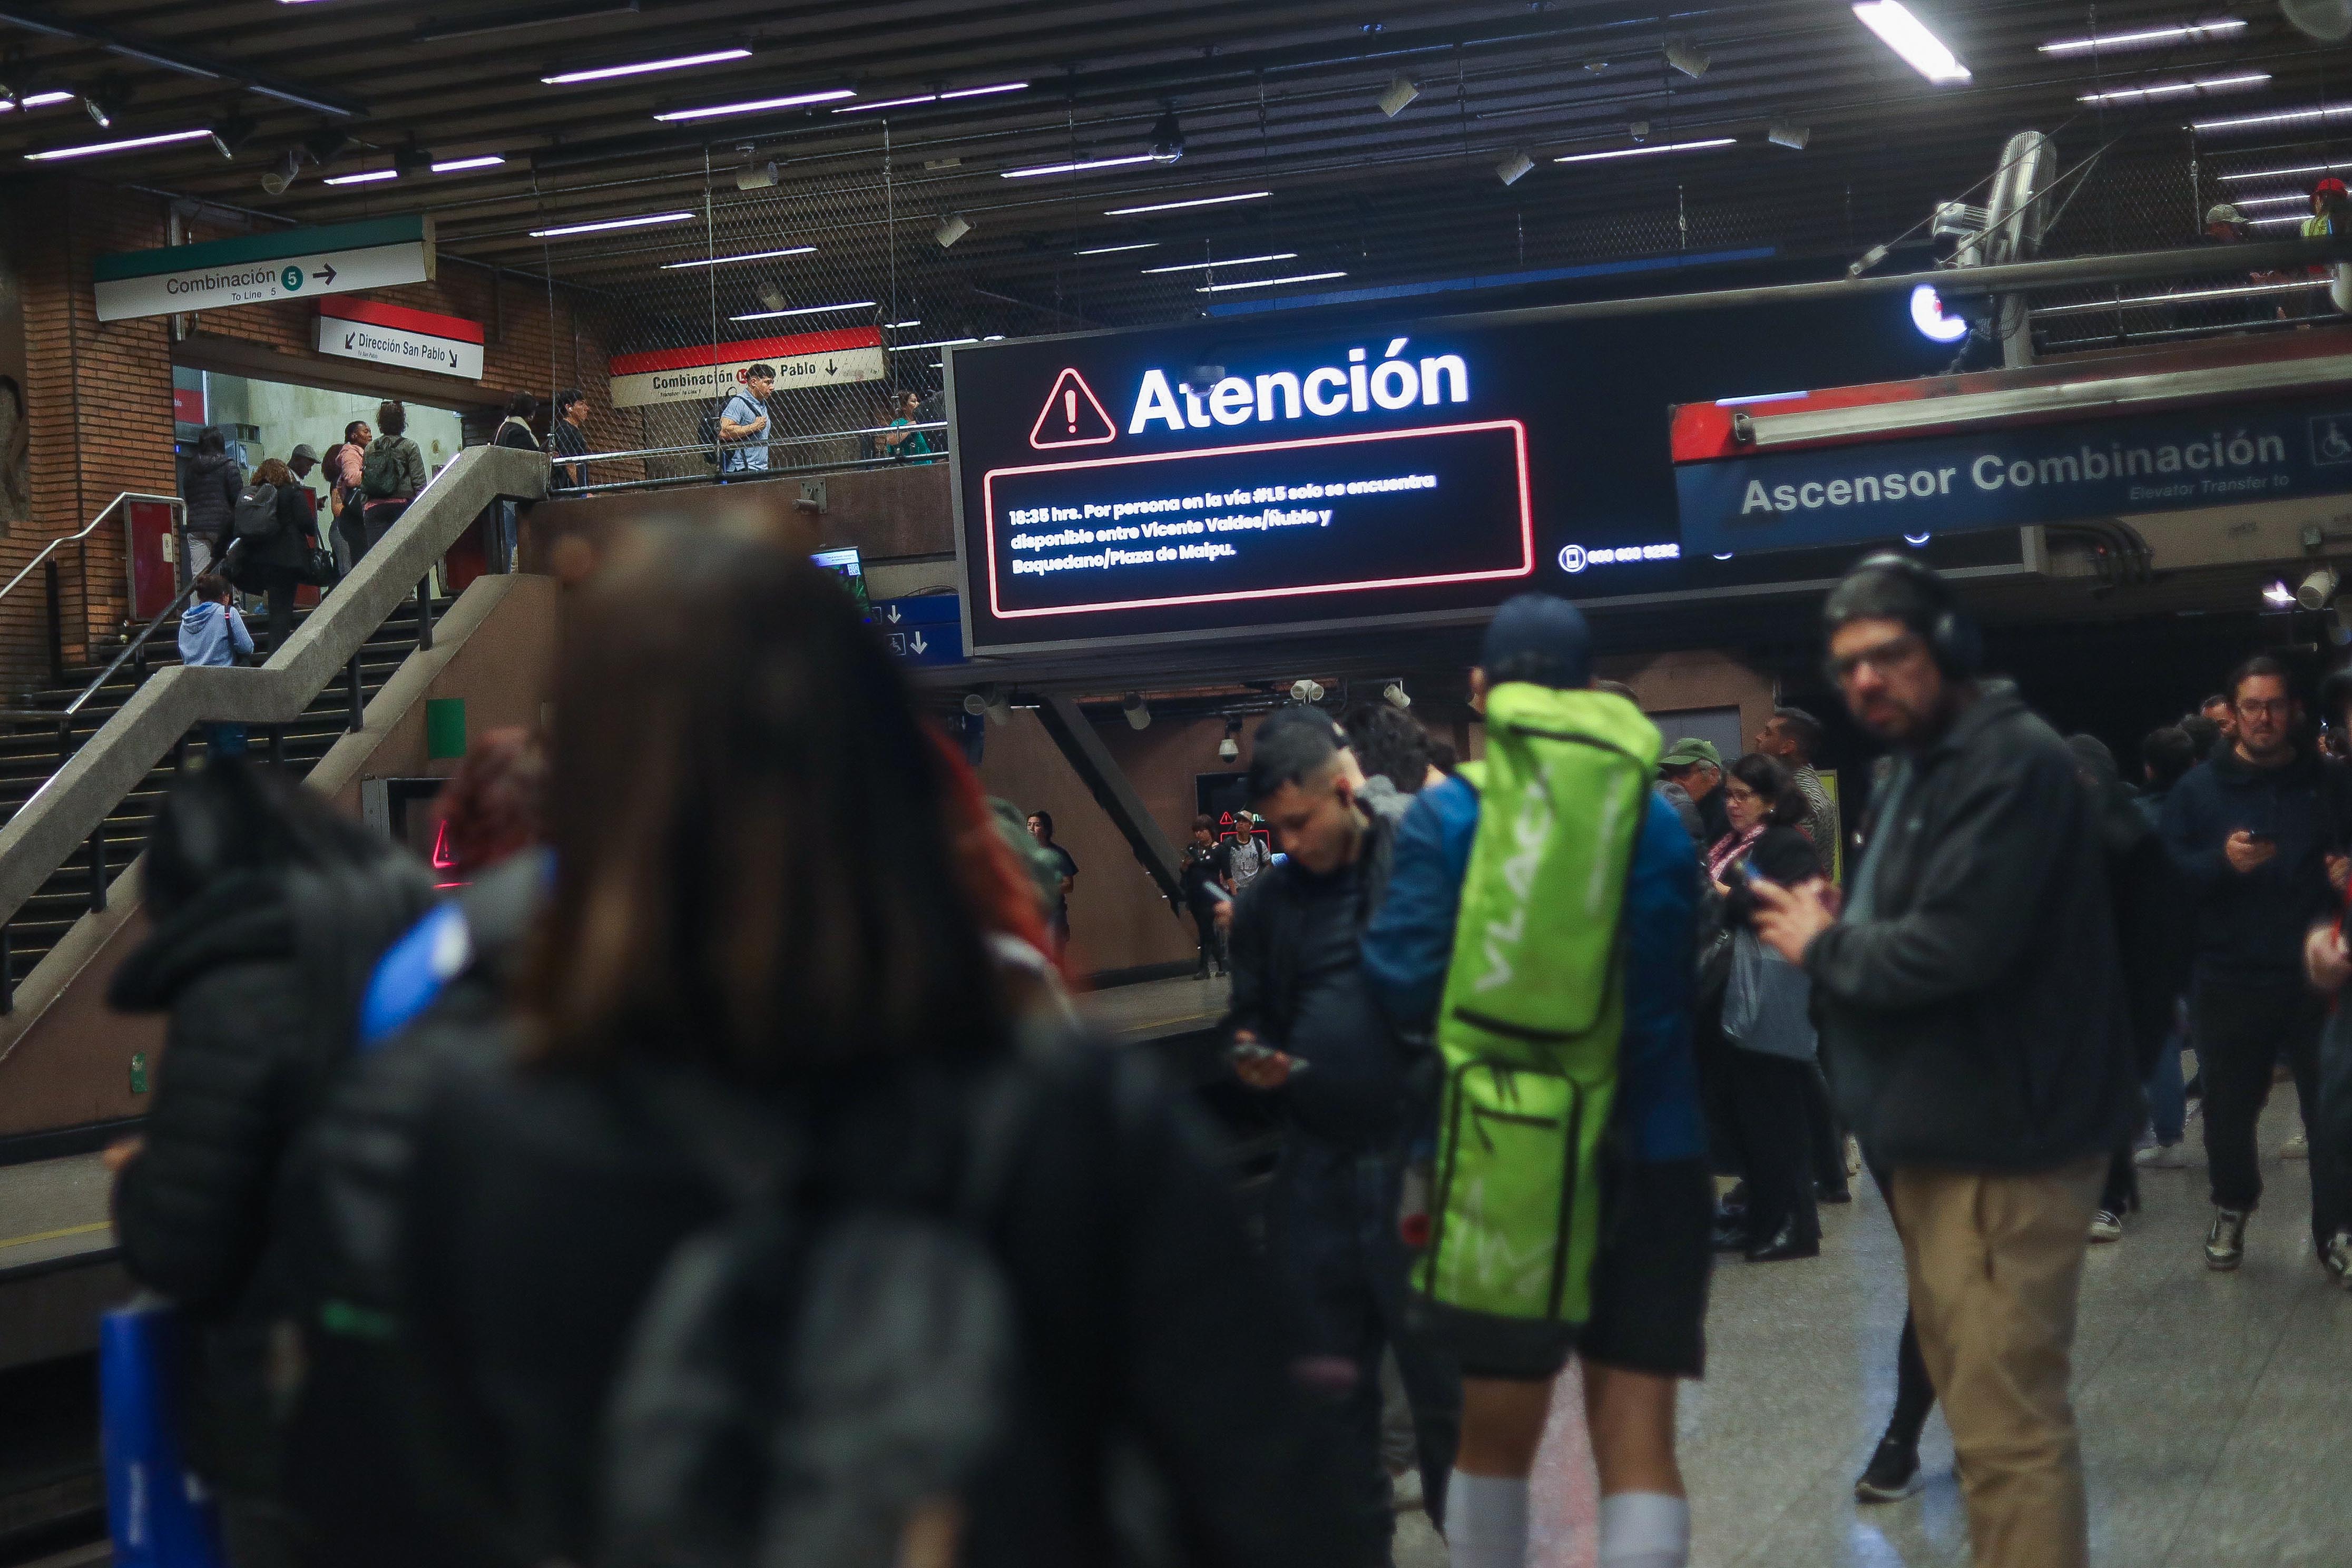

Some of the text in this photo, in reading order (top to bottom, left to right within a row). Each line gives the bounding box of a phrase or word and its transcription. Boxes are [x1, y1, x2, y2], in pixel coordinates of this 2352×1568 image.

[166, 267, 297, 295] Combinación 5
[231, 288, 276, 301] To Line 5
[359, 333, 445, 361] Dirección San Pablo
[653, 370, 733, 389] Combinación
[781, 362, 816, 376] Pablo
[1128, 338, 1468, 434] Atención
[1741, 428, 2287, 516] Ascensor Combinación
[2130, 474, 2290, 500] Elevator Transfer to
[1009, 474, 1435, 525] 18:35 hrs. Por persona en la vía #L5 solo se encuentra
[1011, 528, 1095, 552] disponible
[1096, 526, 1140, 542] entre
[1141, 520, 1204, 538] Vicente
[1319, 509, 1332, 527] y
[1012, 541, 1237, 576] Baquedano/Plaza de Maipu.
